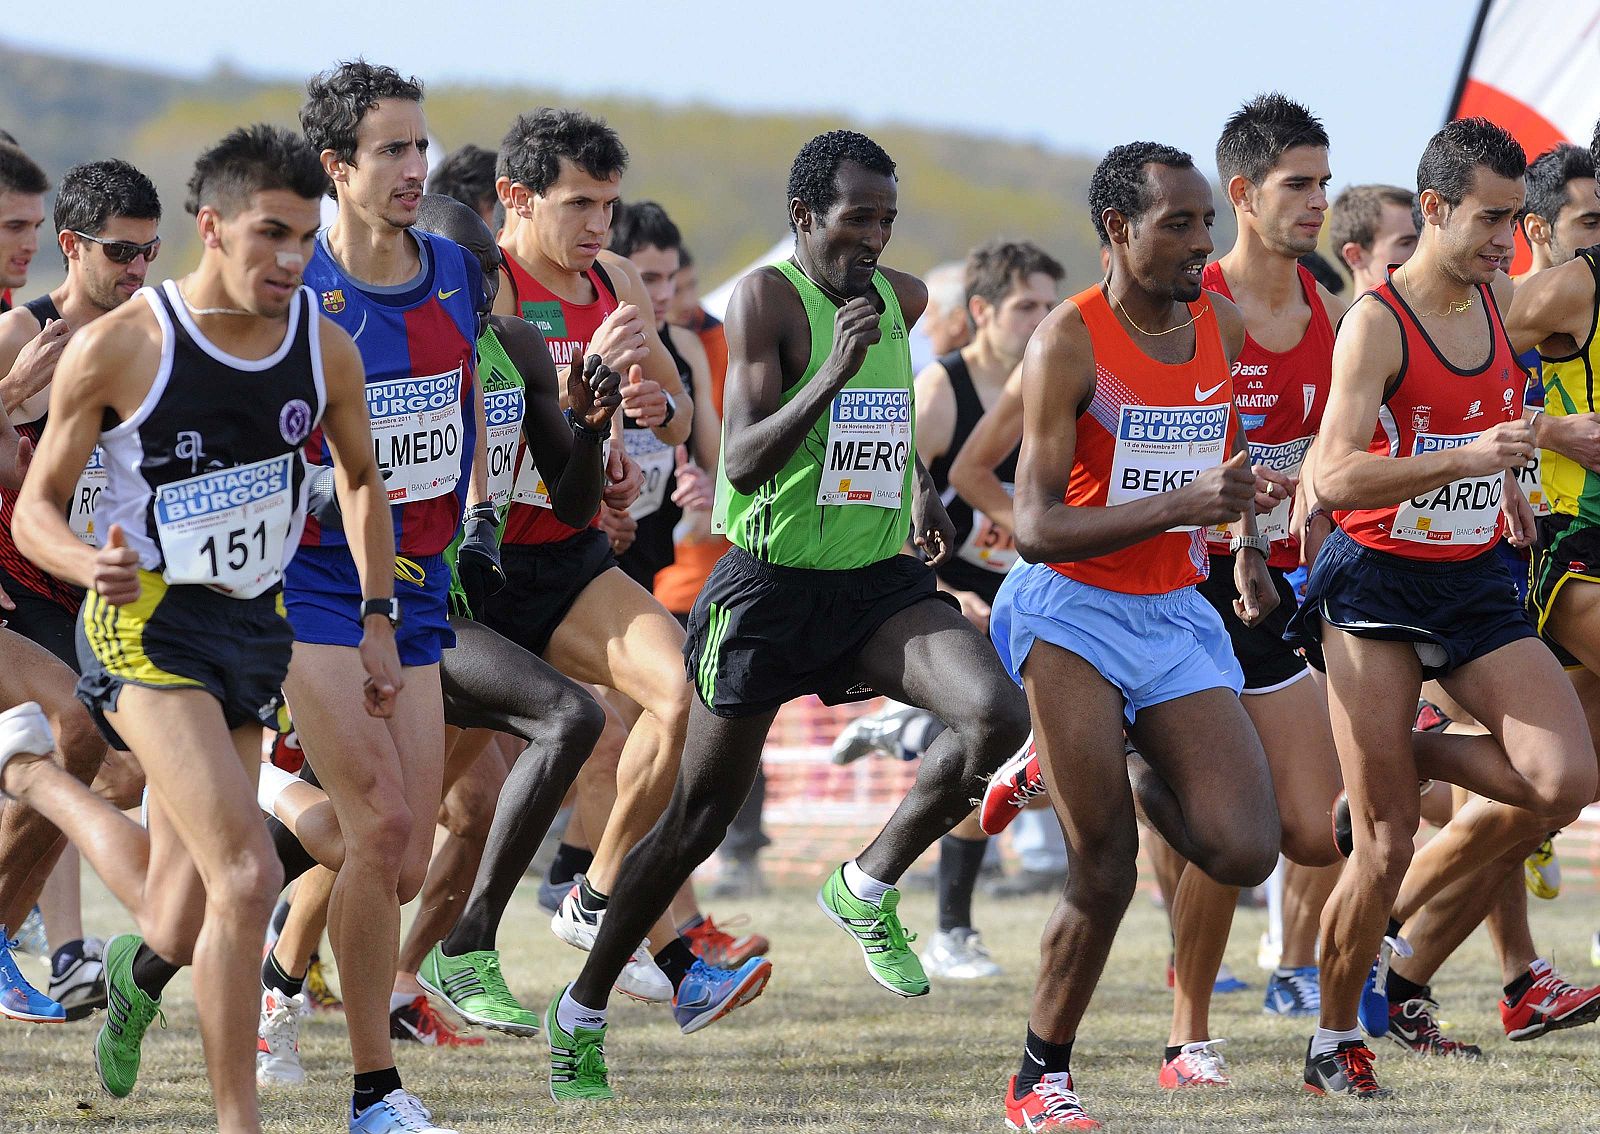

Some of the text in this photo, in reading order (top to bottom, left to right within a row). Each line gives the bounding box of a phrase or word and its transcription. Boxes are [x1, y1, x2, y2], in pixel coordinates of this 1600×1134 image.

[1240, 364, 1269, 376] asics
[366, 374, 457, 402] IPUTACION
[483, 381, 516, 393] adidas
[1247, 380, 1264, 389] A.D.
[371, 388, 455, 417] URGOS
[484, 393, 519, 410] CION
[840, 393, 908, 406] DIPUTACIO
[1232, 393, 1279, 408] ARATHO
[485, 406, 519, 424] OS
[838, 406, 909, 420] BURGO
[1130, 409, 1225, 425] DIPUTACION
[1128, 422, 1224, 441] BURGOS
[374, 423, 458, 470] LMEDO
[1140, 443, 1171, 451] Noviembre
[1248, 439, 1310, 460] IPUTACION
[1511, 456, 1538, 485] R
[163, 461, 284, 505] DIPUTACION
[1121, 467, 1201, 493] BEKE
[166, 475, 283, 521] BURGOS
[387, 490, 404, 500] urgos
[200, 519, 266, 577] 151
